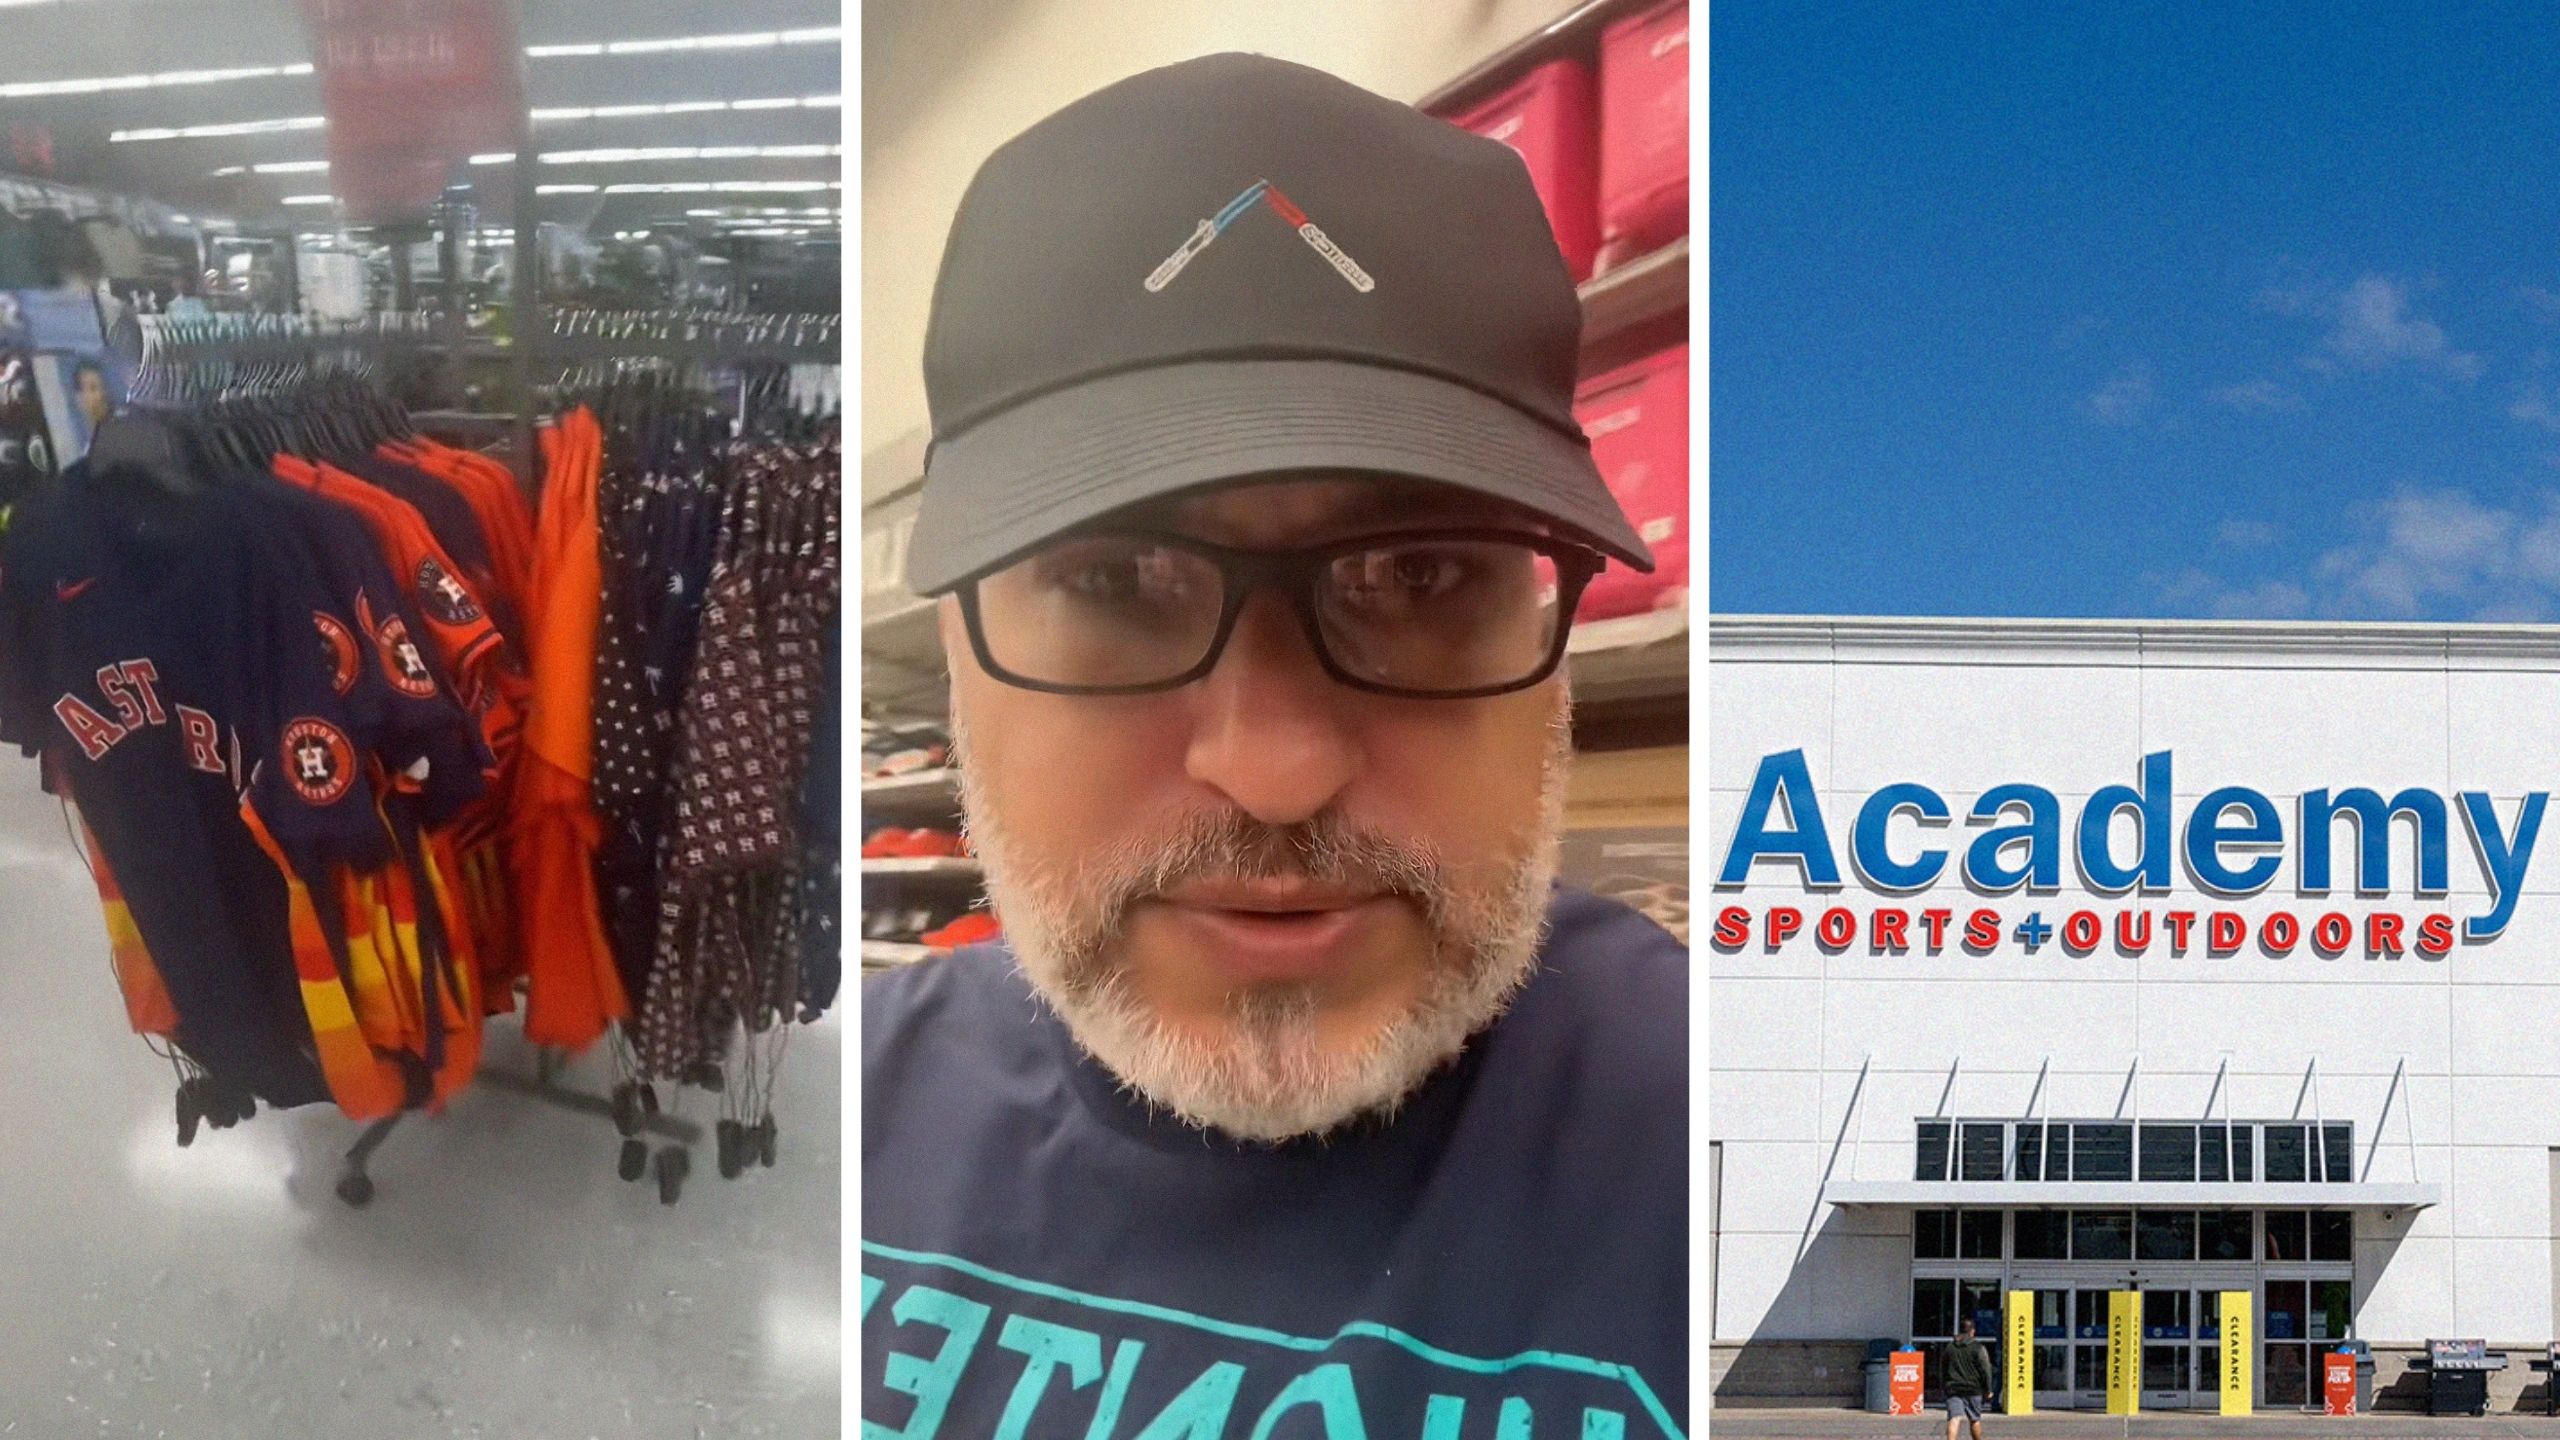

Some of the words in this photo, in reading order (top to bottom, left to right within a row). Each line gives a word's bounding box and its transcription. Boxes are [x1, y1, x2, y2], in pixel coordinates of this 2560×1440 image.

[53, 657, 242, 793] ASTR
[1715, 747, 2551, 938] Academy
[2017, 1315, 2026, 1390] CLEARANCE
[2112, 1315, 2122, 1390] CLEARANCE
[2230, 1316, 2240, 1391] CLEARANCE
